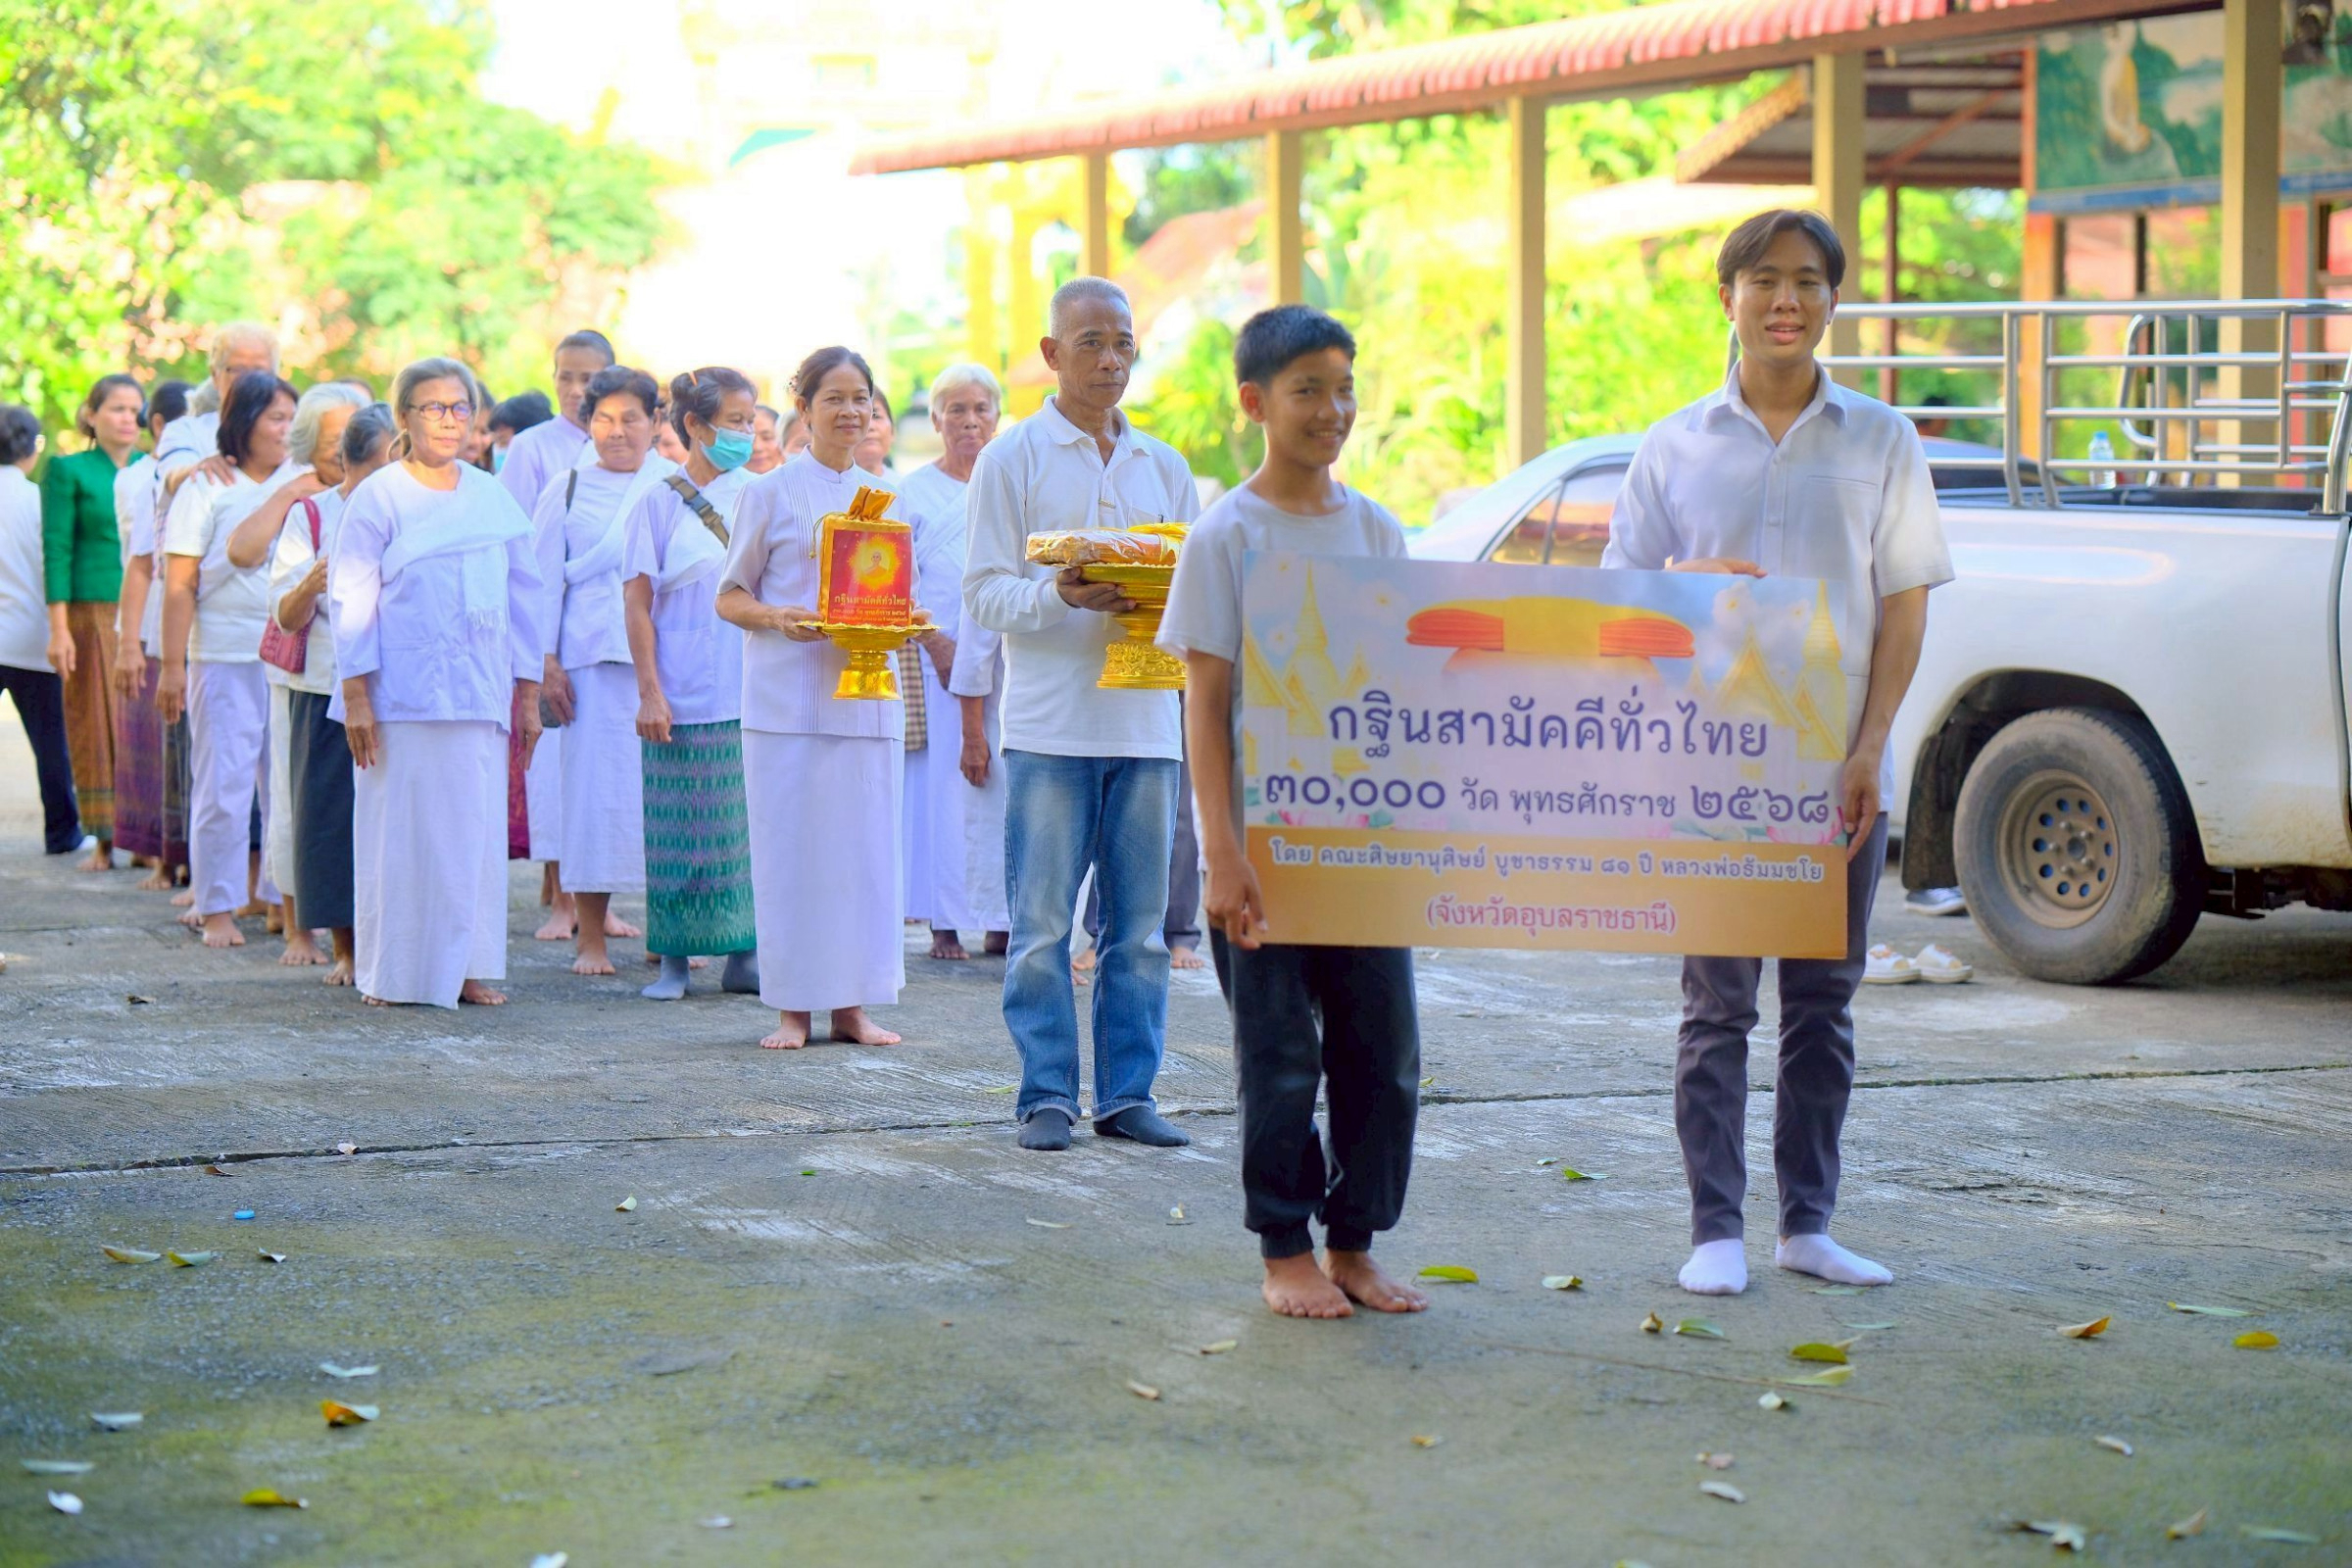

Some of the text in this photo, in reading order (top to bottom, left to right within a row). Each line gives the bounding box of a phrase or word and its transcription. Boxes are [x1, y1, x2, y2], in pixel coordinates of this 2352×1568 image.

[1329, 685, 1767, 759] กฐินสามัคคีทั่วไทย
[1265, 774, 1830, 825] ๓๐,๐๐๐ วัด พุทธศักราช ๒๕๖๘
[1271, 839, 1823, 881] โดย คณะศิษยานุศิษย์ บูชาธรรม ๘๑ ปี หลวงพ่อธัมมชโย
[1427, 895, 1677, 937] (จังหวัดอุบลราชธานี)
